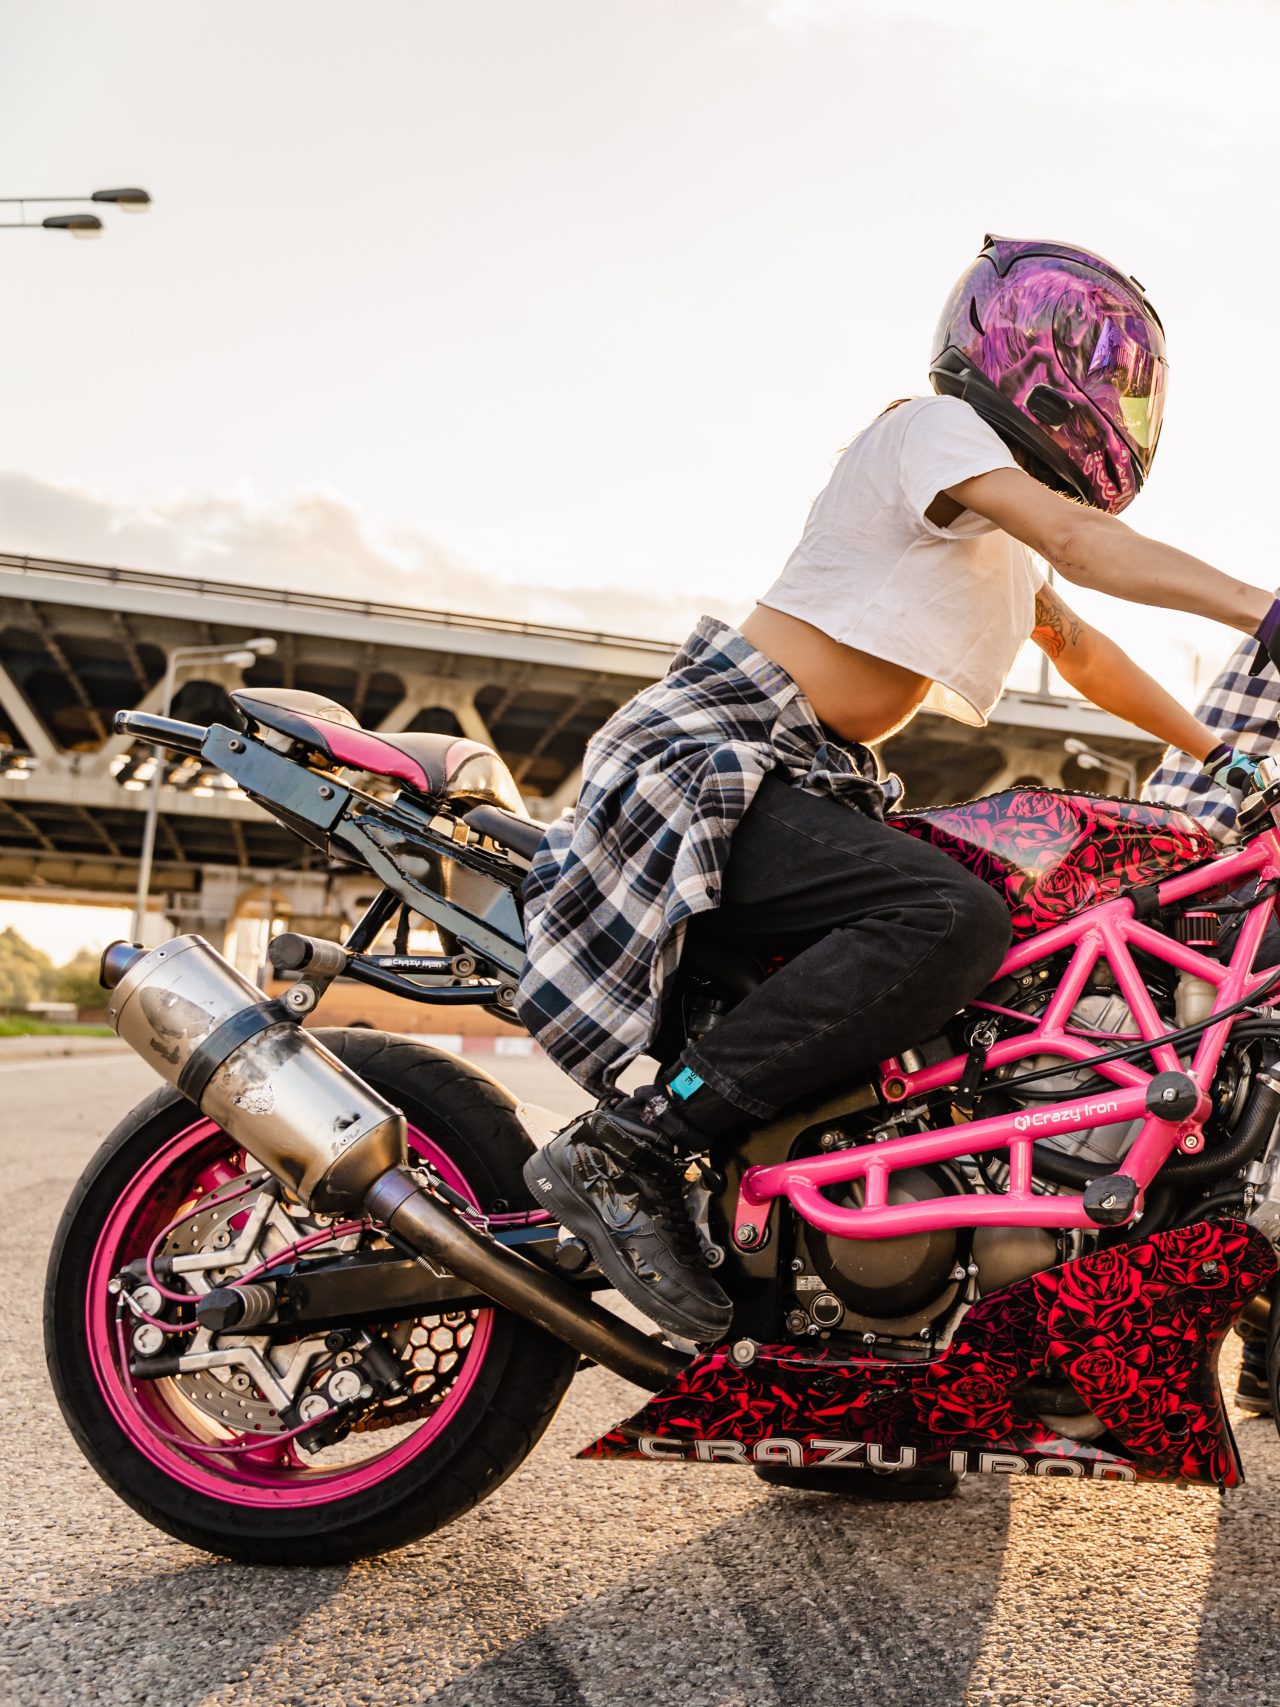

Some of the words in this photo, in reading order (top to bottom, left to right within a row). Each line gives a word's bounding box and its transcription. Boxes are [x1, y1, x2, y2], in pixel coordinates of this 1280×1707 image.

[1032, 1107, 1081, 1126] Crazy
[1084, 1101, 1118, 1117] Iron
[536, 1177, 553, 1193] AIR
[638, 1437, 918, 1469] CRAZY
